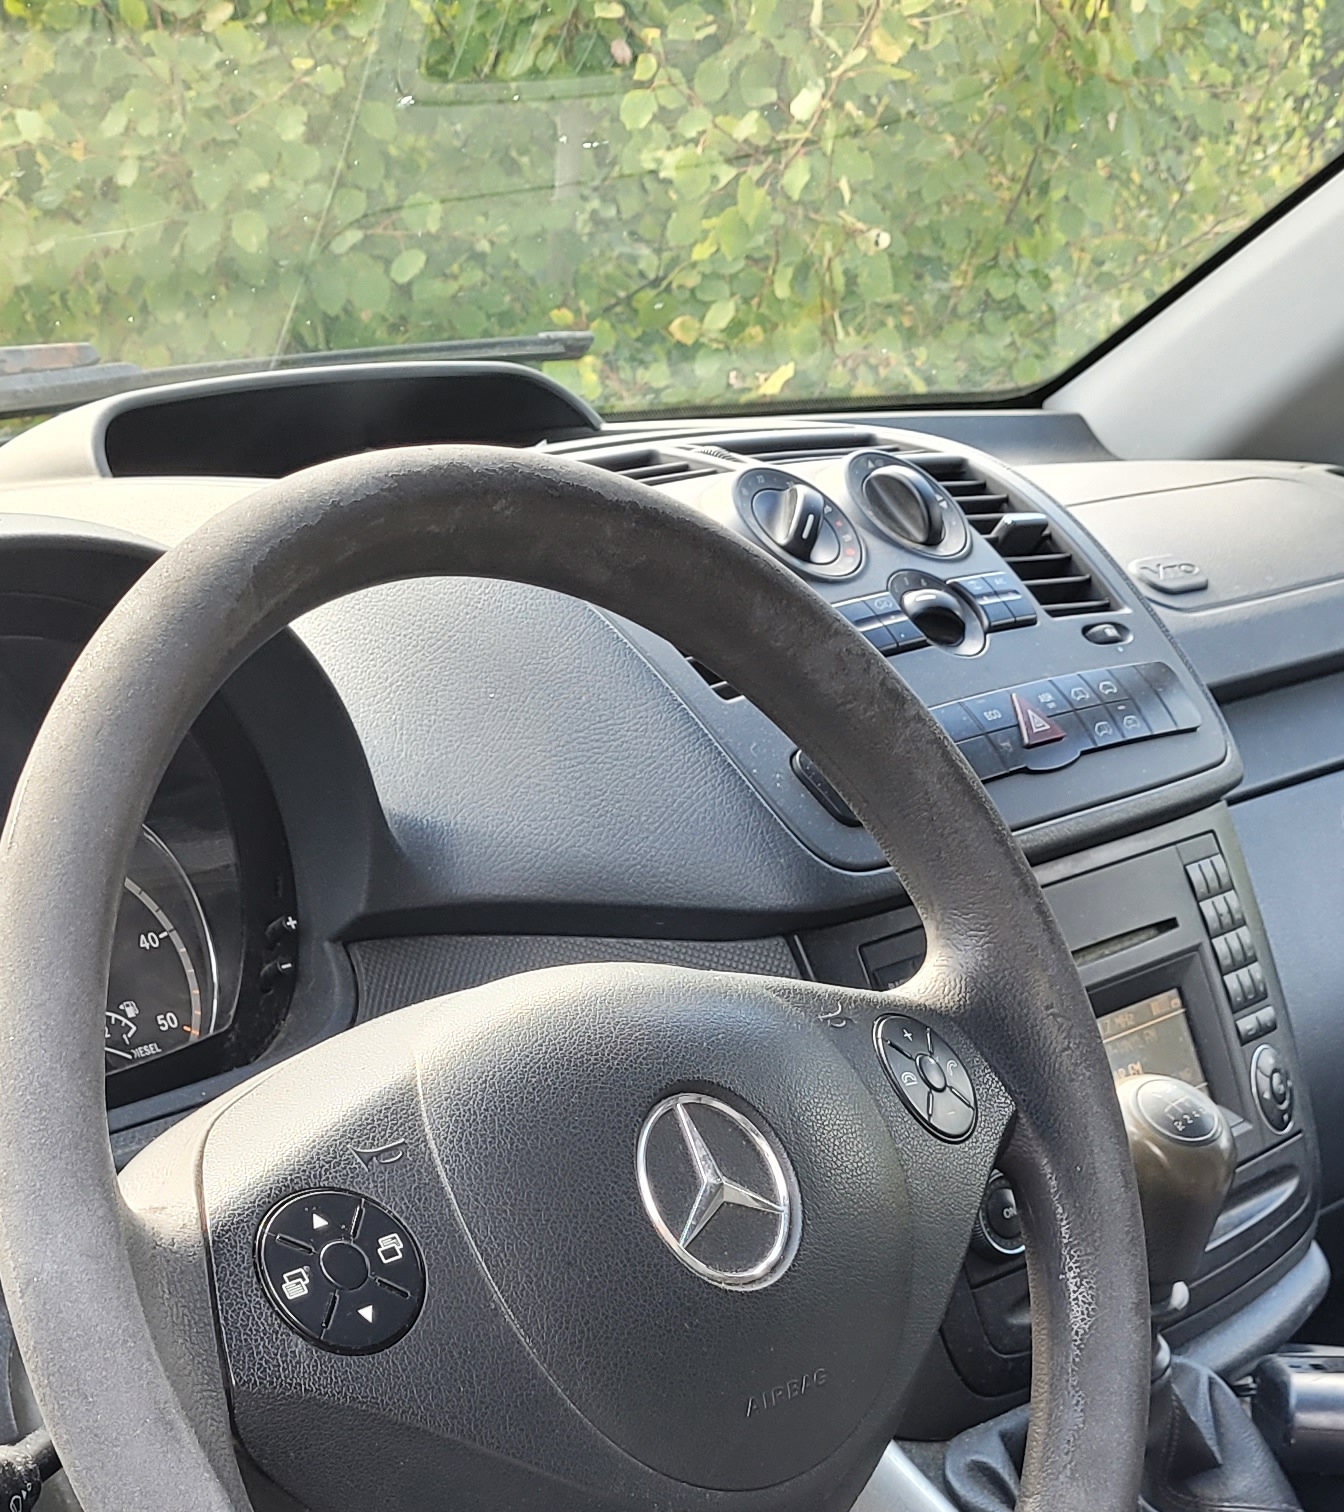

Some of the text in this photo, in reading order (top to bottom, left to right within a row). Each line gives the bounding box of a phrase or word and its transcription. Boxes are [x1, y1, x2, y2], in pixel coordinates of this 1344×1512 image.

[983, 709, 1002, 721] ECO
[139, 932, 160, 950] 40
[156, 1012, 179, 1031] 50
[745, 1368, 827, 1418] AIRBAG
